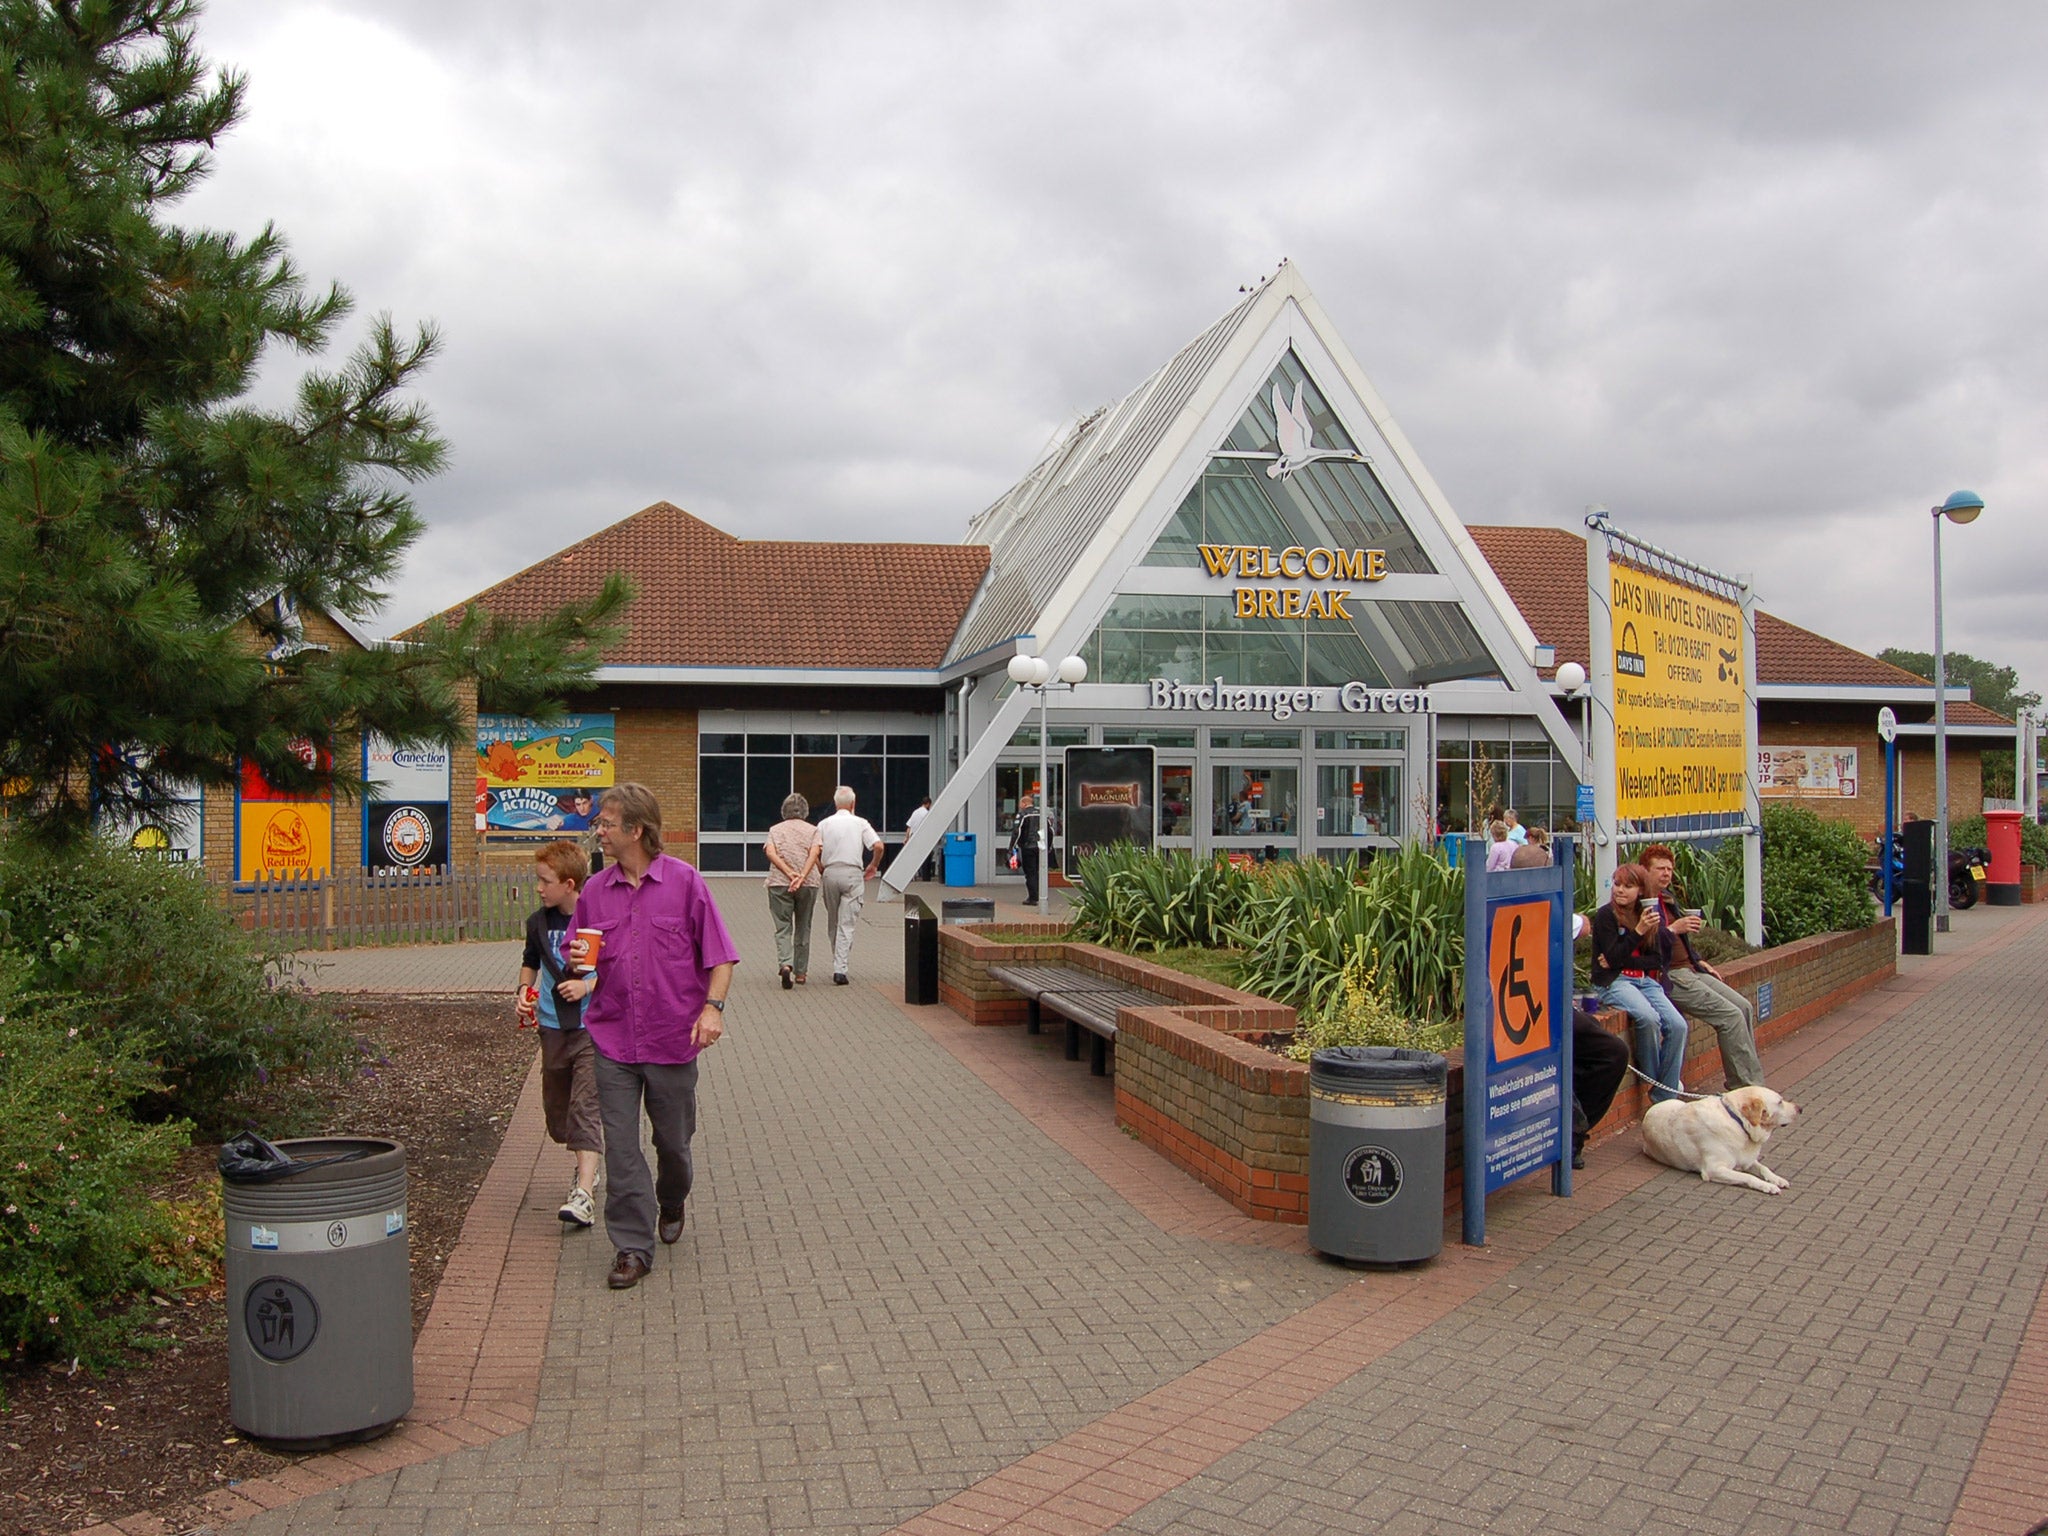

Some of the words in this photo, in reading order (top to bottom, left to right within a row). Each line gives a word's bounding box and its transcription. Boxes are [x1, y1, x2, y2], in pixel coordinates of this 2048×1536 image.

[1197, 543, 1387, 581] WELCOME
[1234, 587, 1353, 620] BREAK
[1614, 578, 1642, 614] DAYS
[1644, 588, 1662, 618] INN
[1664, 594, 1694, 628] HOTEL
[1696, 604, 1738, 640] STANSTED
[1653, 631, 1667, 654] Tel:
[1669, 634, 1688, 657] 01279
[1617, 654, 1633, 672] DAYS
[1633, 658, 1644, 674] INN
[1667, 664, 1702, 683] OFFERING
[1148, 676, 1323, 721] Birchanger
[1338, 680, 1434, 713] Green
[1617, 688, 1628, 705] SKY
[1617, 724, 1635, 754] Family
[1635, 725, 1652, 748] Rooms
[1666, 727, 1696, 748] CONDITIONED
[372, 751, 392, 762] food
[392, 749, 446, 768] Connection
[1619, 766, 1659, 800] Weekend
[1660, 765, 1681, 797] Rates
[1682, 765, 1704, 795] FROM
[1717, 771, 1728, 800] per
[499, 788, 521, 801] FLY
[524, 788, 558, 806] INTO
[502, 799, 553, 816] ACTION!
[1090, 793, 1128, 801] MAGNUM
[386, 810, 409, 843] COFFEE
[410, 810, 431, 843] PRIMO
[267, 857, 285, 867] Red
[287, 857, 306, 867] Hen
[1489, 1076, 1524, 1099] Wheelchairs
[1524, 1073, 1534, 1087] are
[1534, 1064, 1557, 1083] available
[1490, 1103, 1510, 1120] Please
[1510, 1099, 1521, 1112] see
[1521, 1083, 1556, 1108] management
